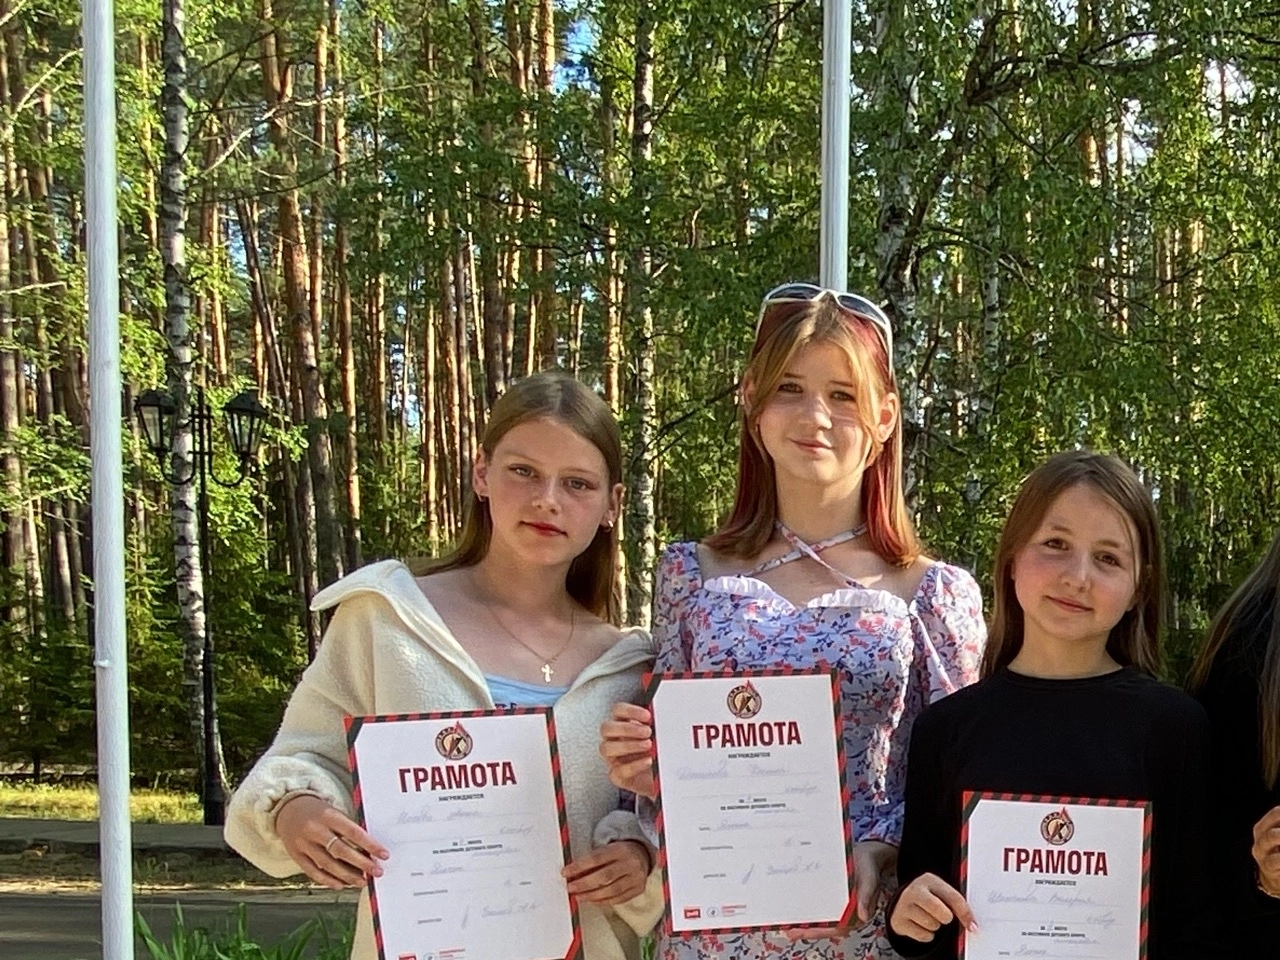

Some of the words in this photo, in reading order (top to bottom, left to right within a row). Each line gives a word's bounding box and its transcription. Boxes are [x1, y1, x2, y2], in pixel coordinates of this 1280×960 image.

[692, 721, 802, 749] ГРАМОТА
[399, 761, 518, 794] ГРАМОТА
[1003, 847, 1109, 876] ГРАМОТА
